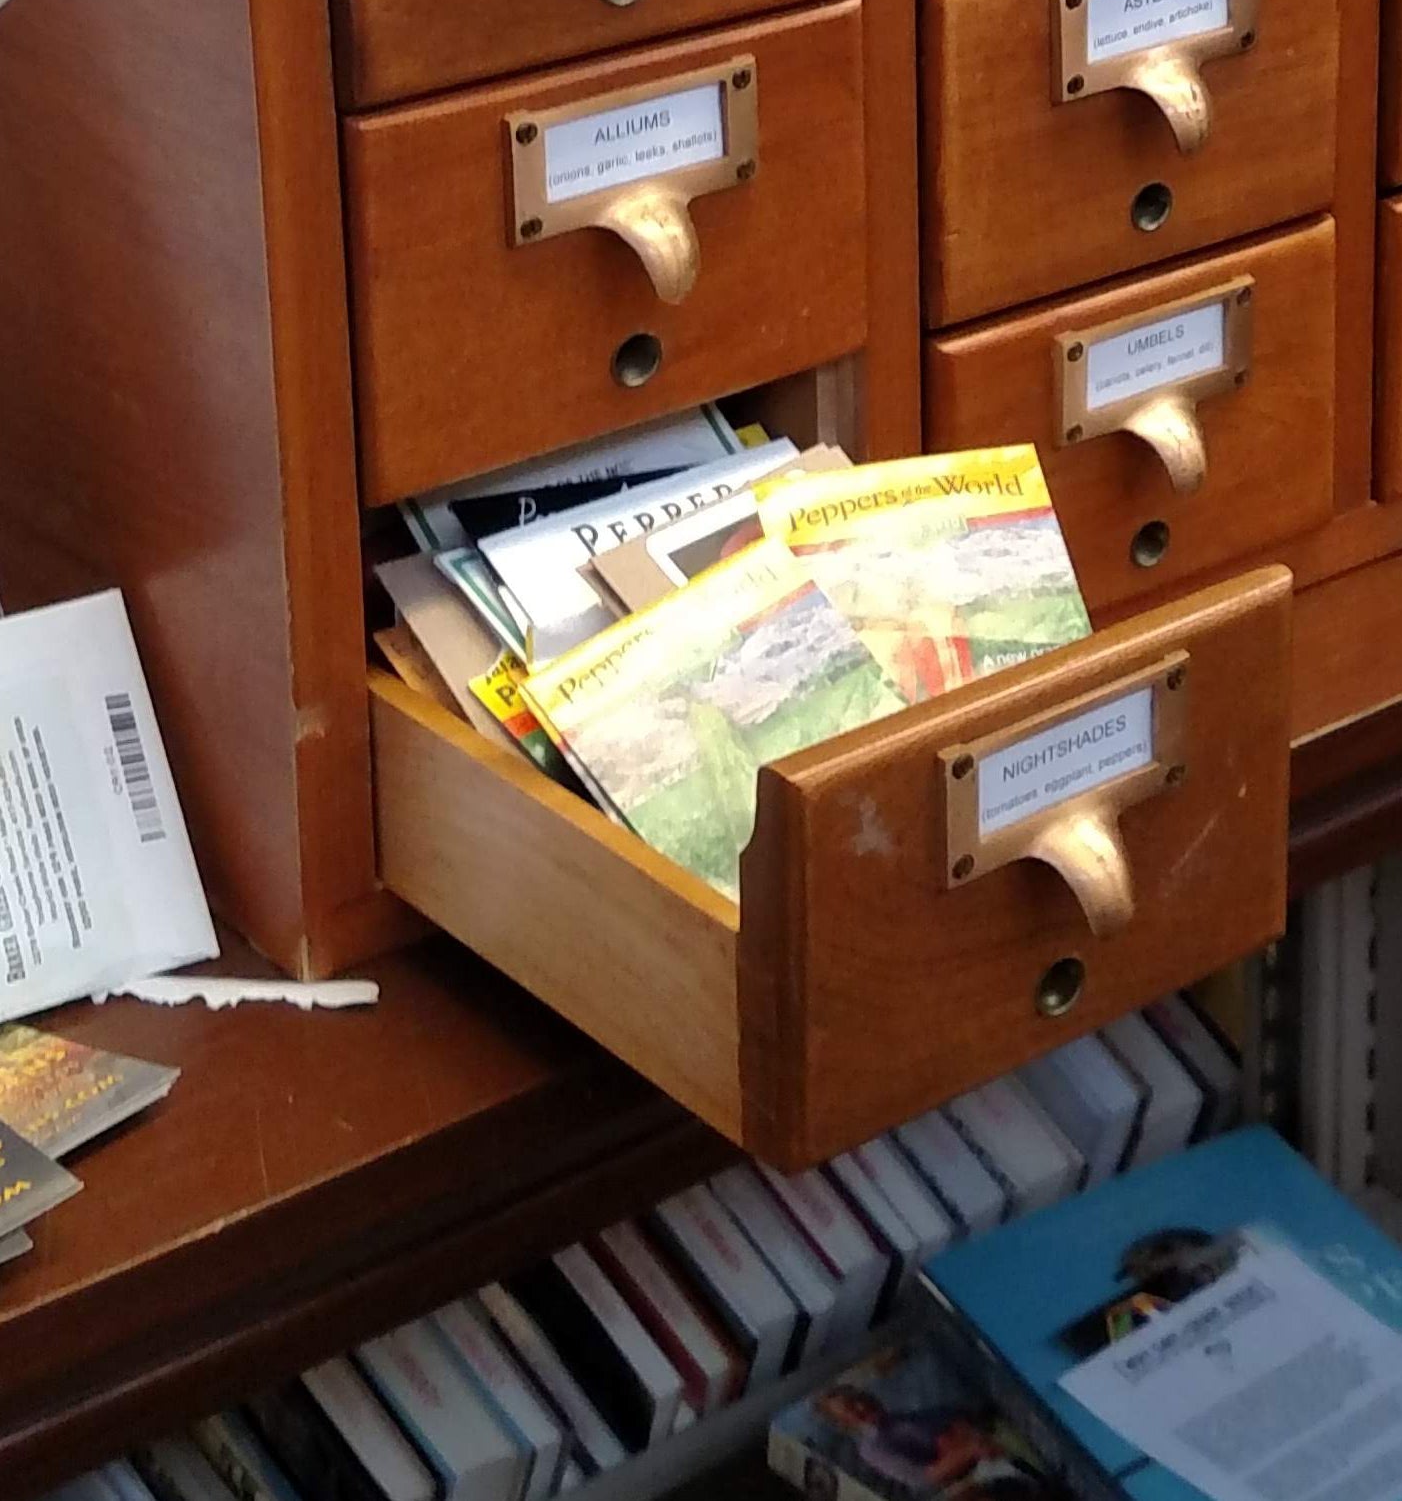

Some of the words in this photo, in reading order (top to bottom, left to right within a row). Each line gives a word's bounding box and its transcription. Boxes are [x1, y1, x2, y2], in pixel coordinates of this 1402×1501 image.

[594, 109, 671, 146] ALLIUMS
[1127, 323, 1185, 356] UMBELS
[788, 488, 898, 533] Peppers
[915, 483, 932, 497] the
[932, 472, 1025, 498] World
[996, 650, 1027, 666] new
[1002, 714, 1127, 782] NIGHTSHADES
